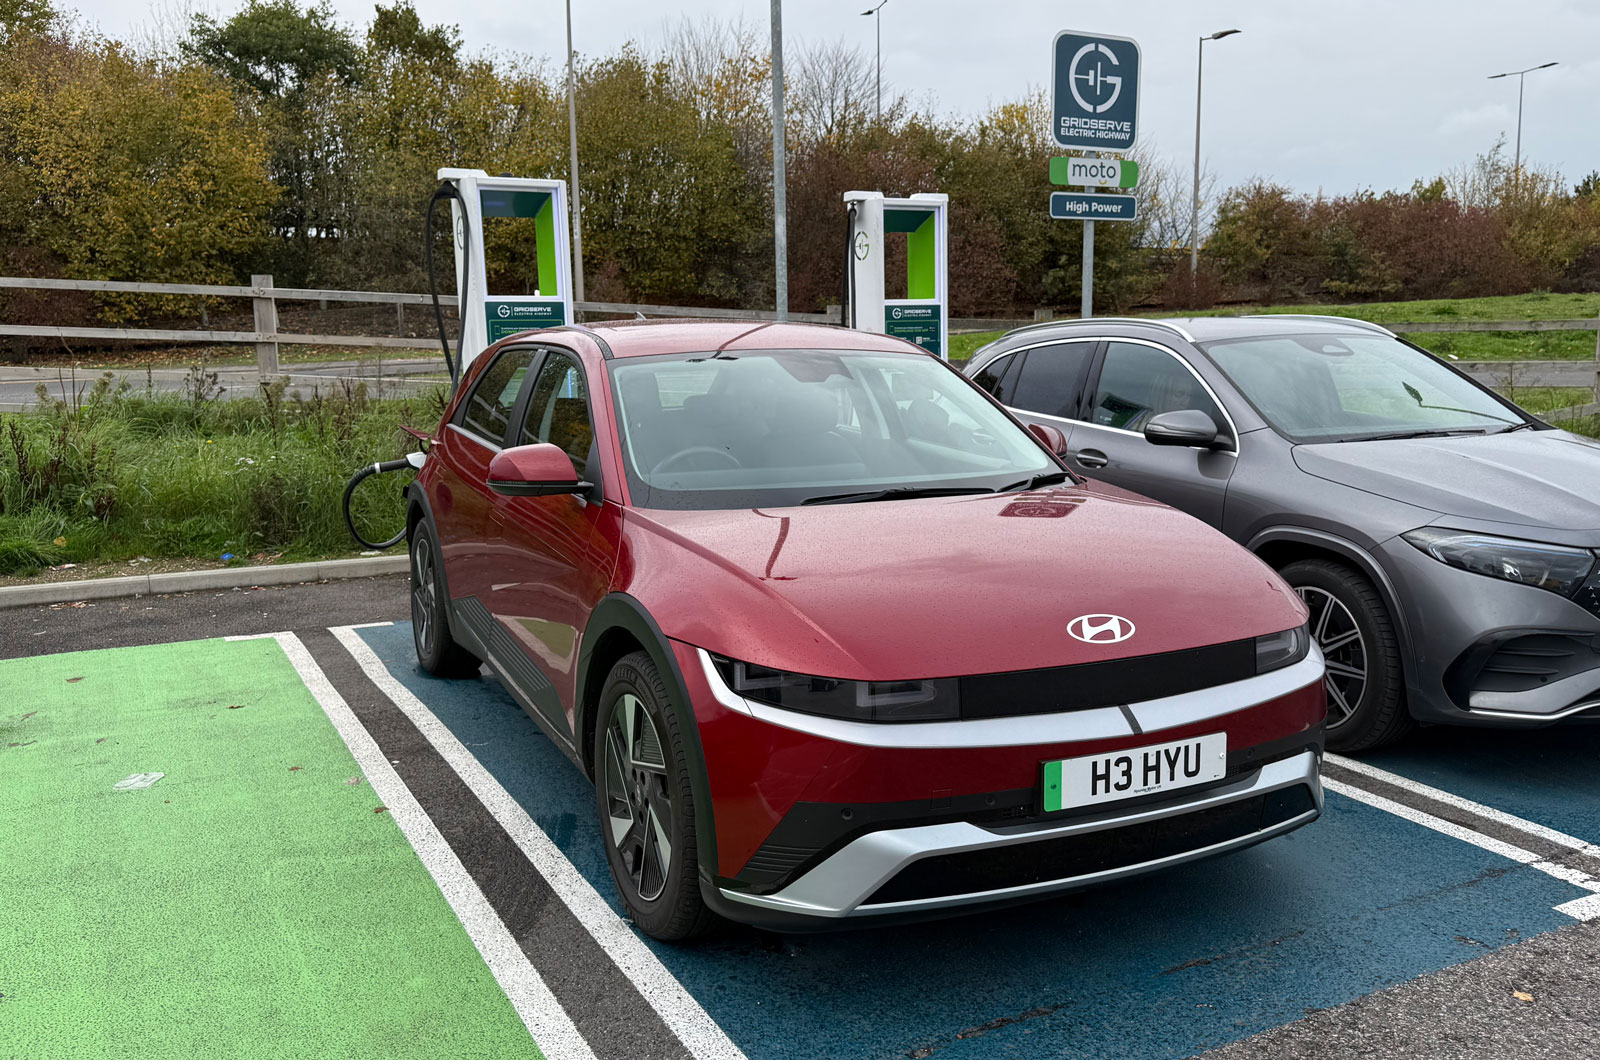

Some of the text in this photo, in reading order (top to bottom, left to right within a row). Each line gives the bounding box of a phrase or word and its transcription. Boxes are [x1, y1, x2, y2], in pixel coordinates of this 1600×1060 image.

[1060, 116, 1132, 132] GRIDSERVE
[1060, 129, 1131, 141] ELECTRIC HIGHWAY
[1071, 161, 1117, 179] moto
[1065, 201, 1123, 213] High Power
[1091, 743, 1201, 796] H3 HYU
